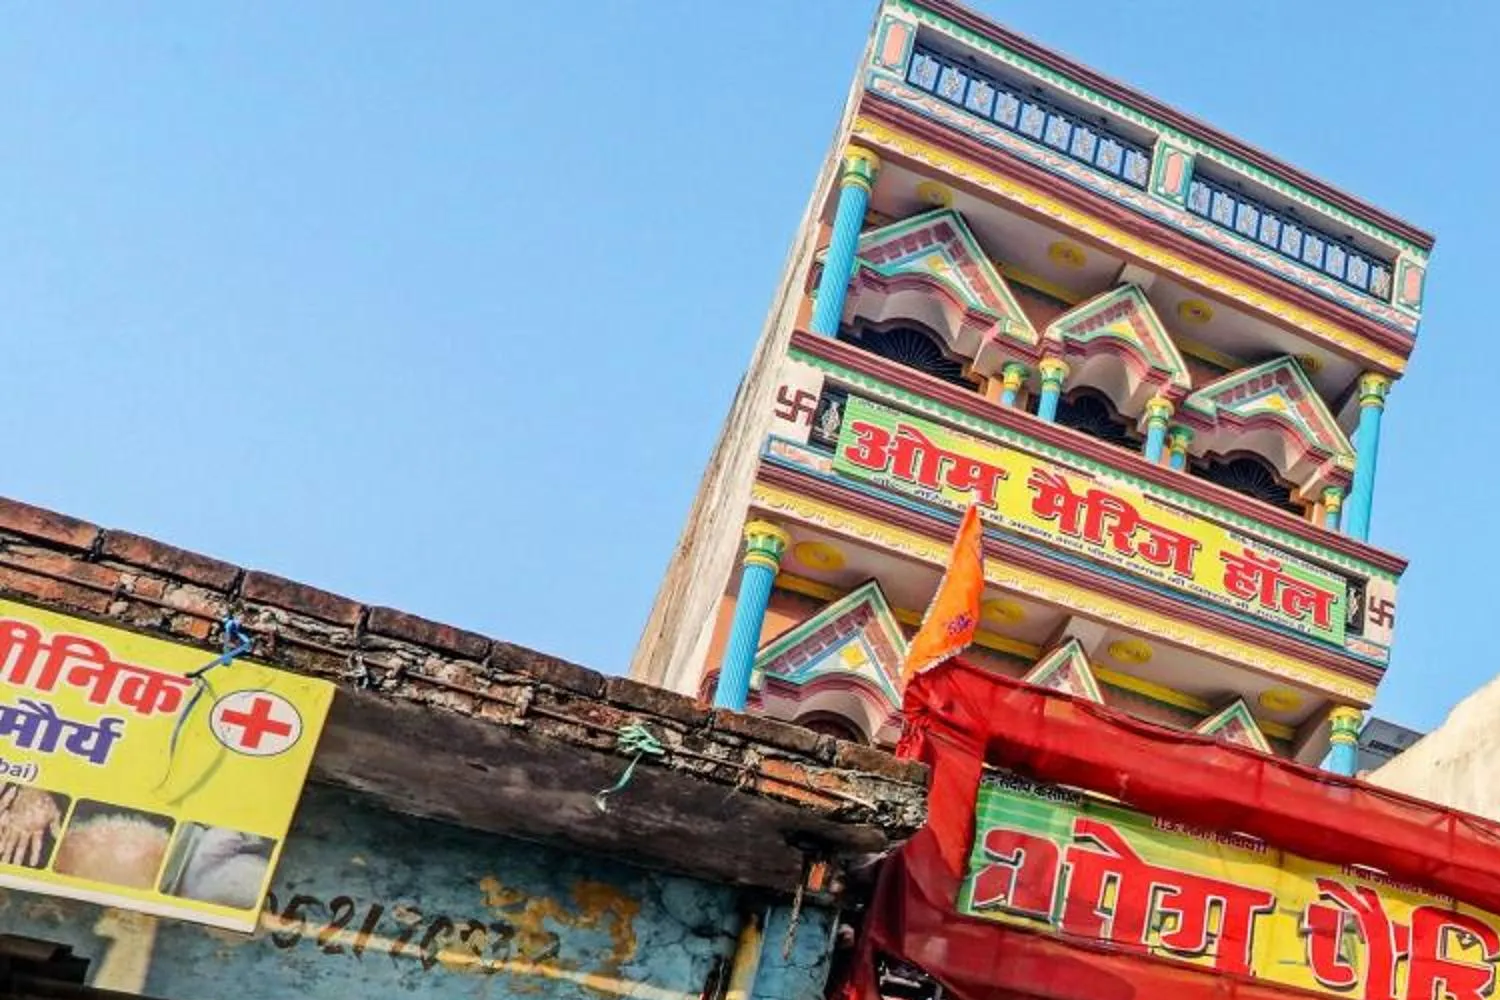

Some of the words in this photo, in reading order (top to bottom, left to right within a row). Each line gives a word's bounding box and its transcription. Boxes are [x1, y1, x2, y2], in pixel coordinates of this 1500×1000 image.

[842, 421, 1008, 509] ओम
[1027, 466, 1203, 581] मैरिज
[1218, 547, 1340, 632] हॉल
